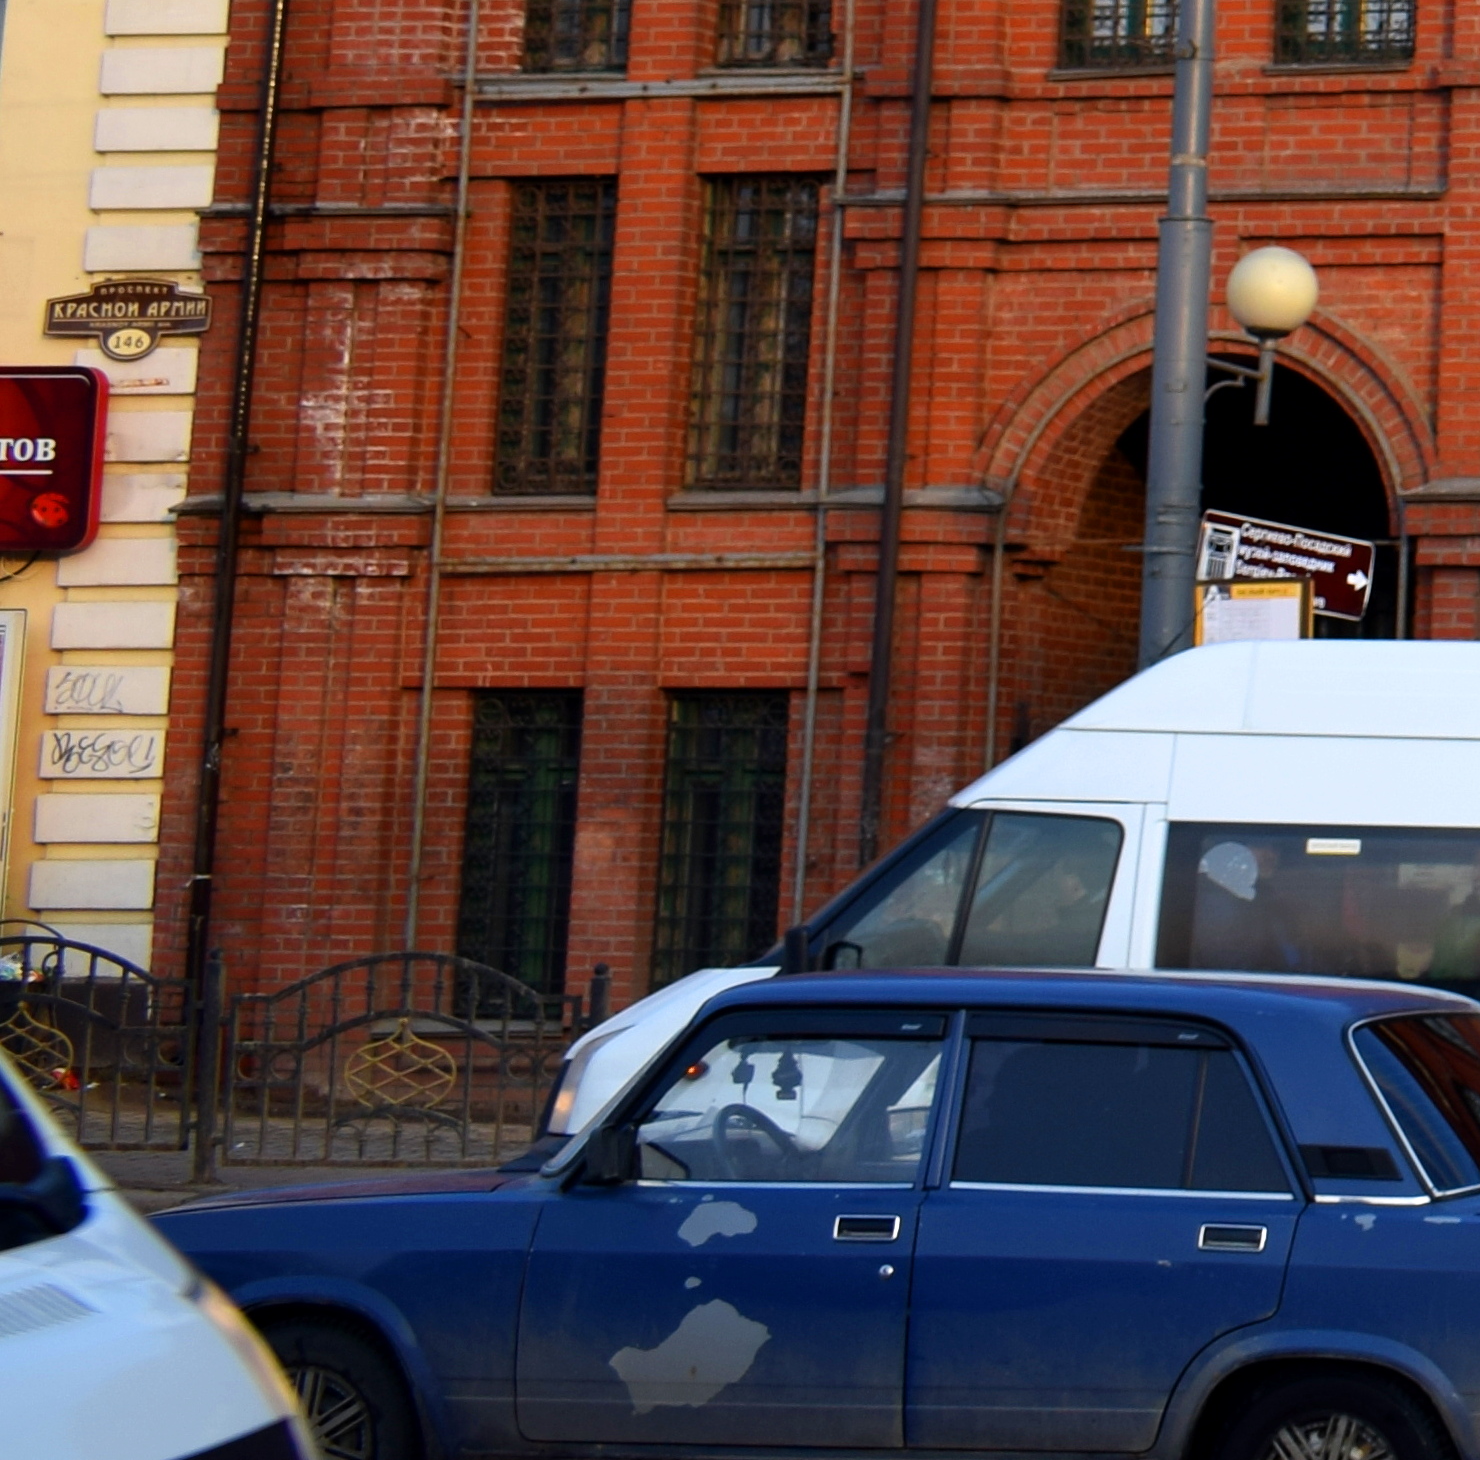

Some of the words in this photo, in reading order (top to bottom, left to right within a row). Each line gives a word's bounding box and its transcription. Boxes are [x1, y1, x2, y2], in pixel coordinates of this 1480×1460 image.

[100, 285, 168, 296] ПРОСПЕКТ
[146, 299, 207, 318] АРМИИ
[113, 335, 145, 350] 146
